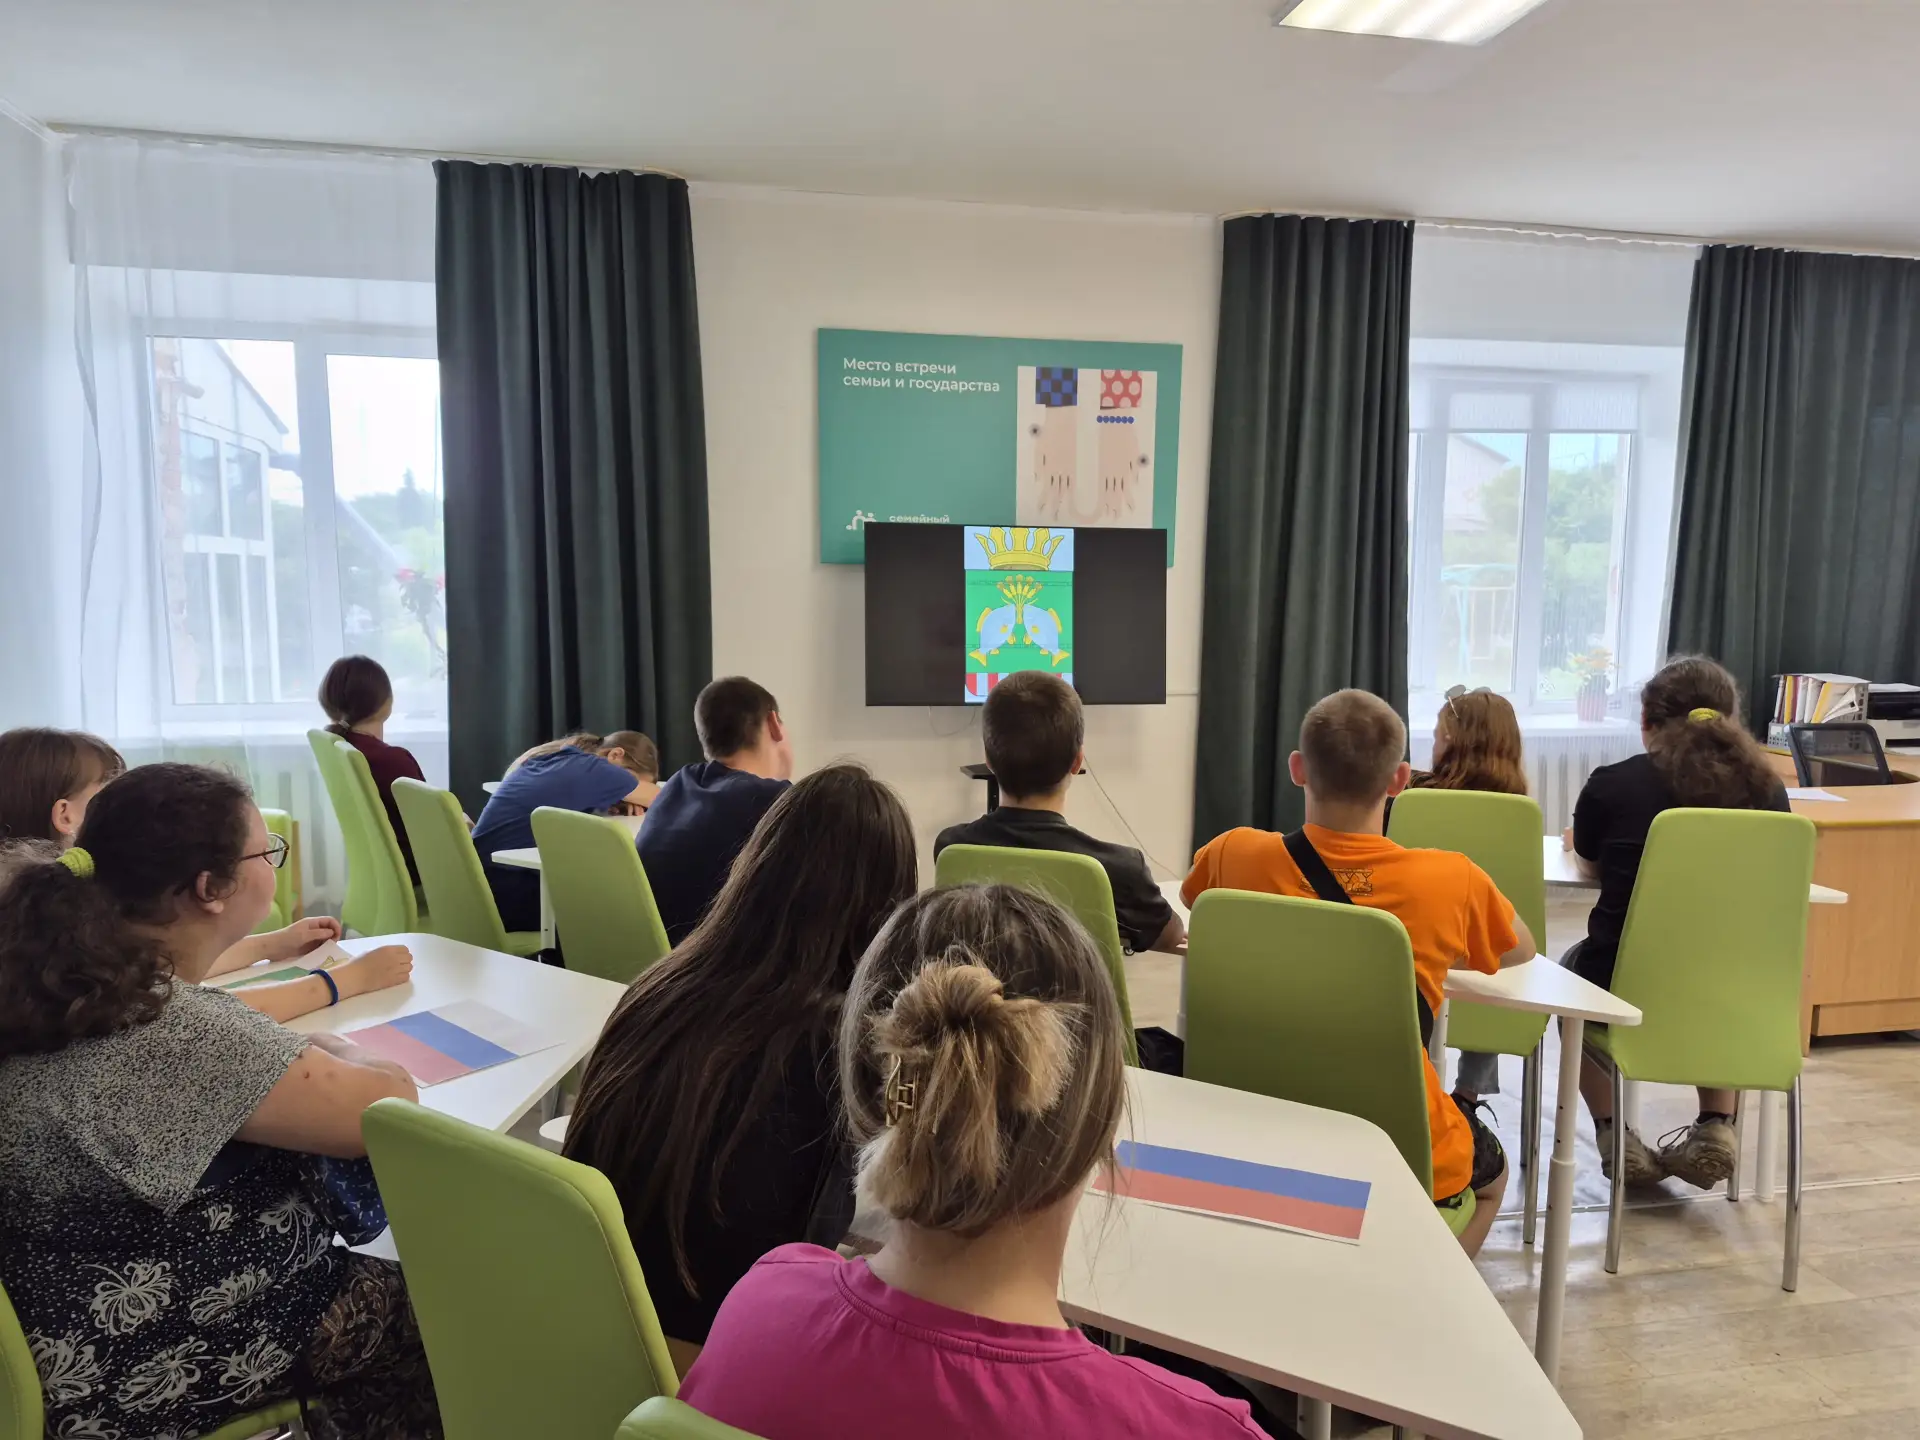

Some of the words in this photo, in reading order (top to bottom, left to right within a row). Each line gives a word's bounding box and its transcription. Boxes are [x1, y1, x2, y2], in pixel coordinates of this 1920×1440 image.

[843, 357, 891, 371] Место
[895, 362, 957, 375] встречи
[843, 375, 891, 388] семьи
[895, 379, 905, 388] и
[909, 378, 1000, 393] государства
[889, 514, 950, 523] семейный
